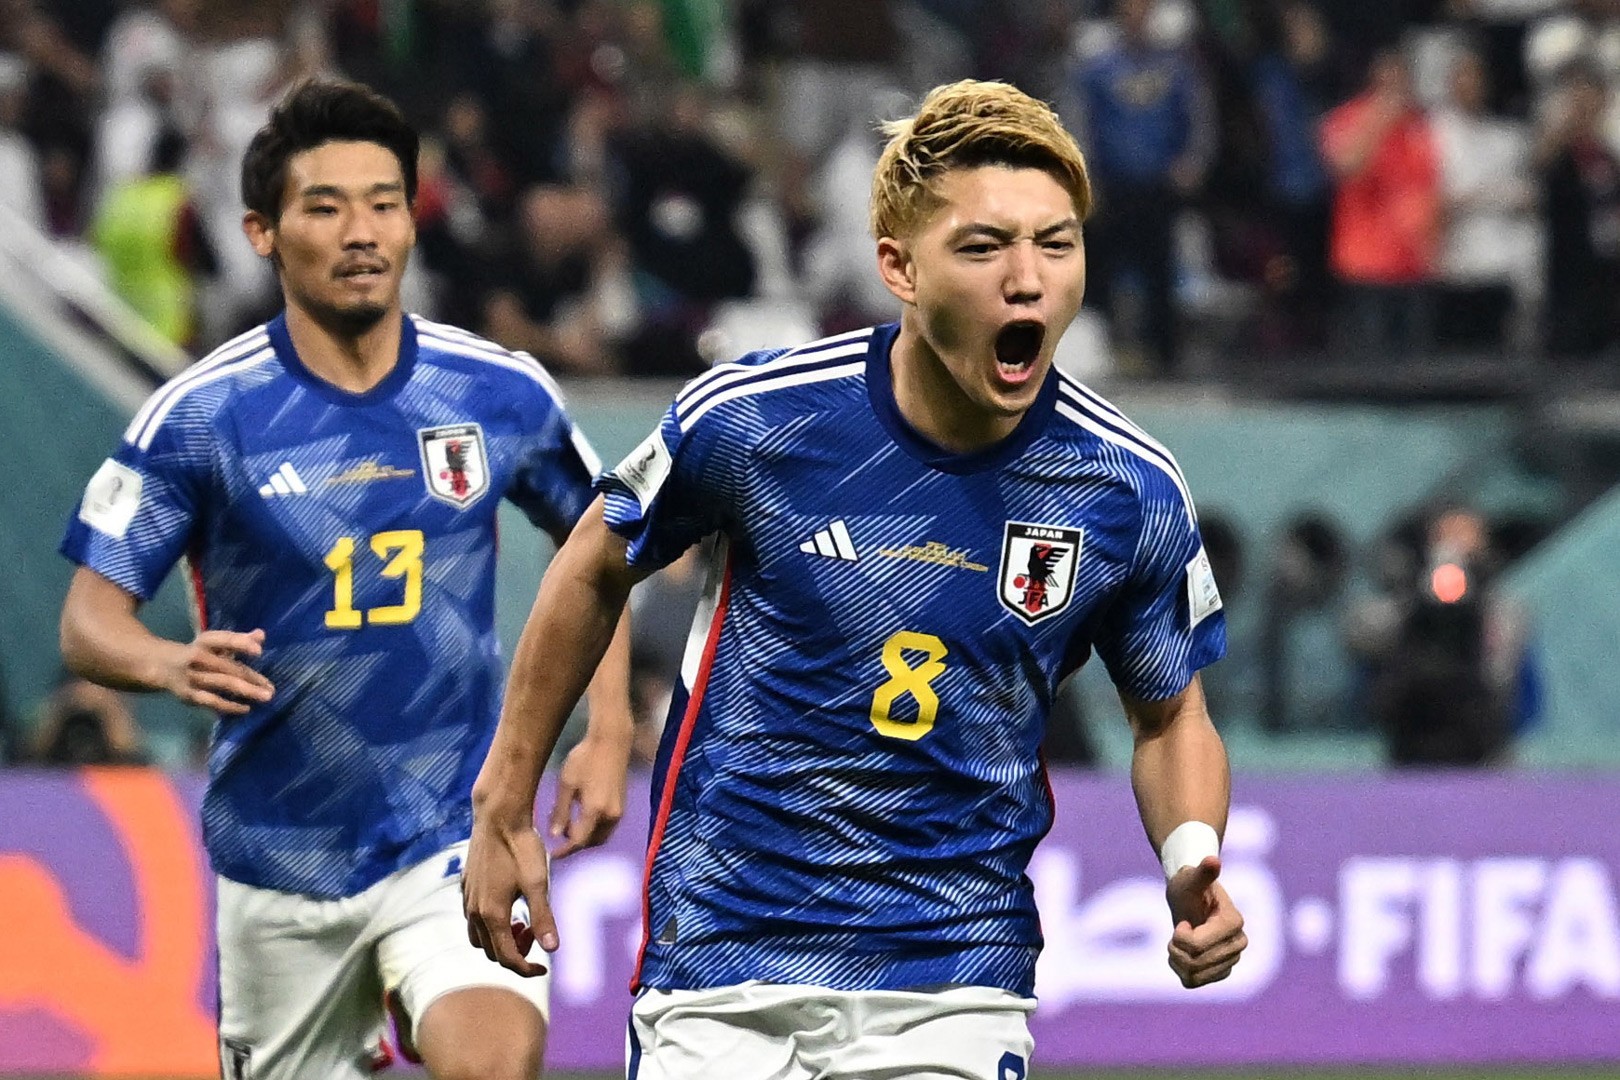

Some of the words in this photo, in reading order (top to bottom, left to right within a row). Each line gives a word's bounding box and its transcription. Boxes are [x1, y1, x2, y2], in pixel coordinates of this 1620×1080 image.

[323, 529, 425, 629] 13
[1025, 527, 1064, 539] JAPAN
[1017, 590, 1049, 607] JFA
[869, 630, 949, 741] 8
[1337, 856, 1620, 1001] FIFA
